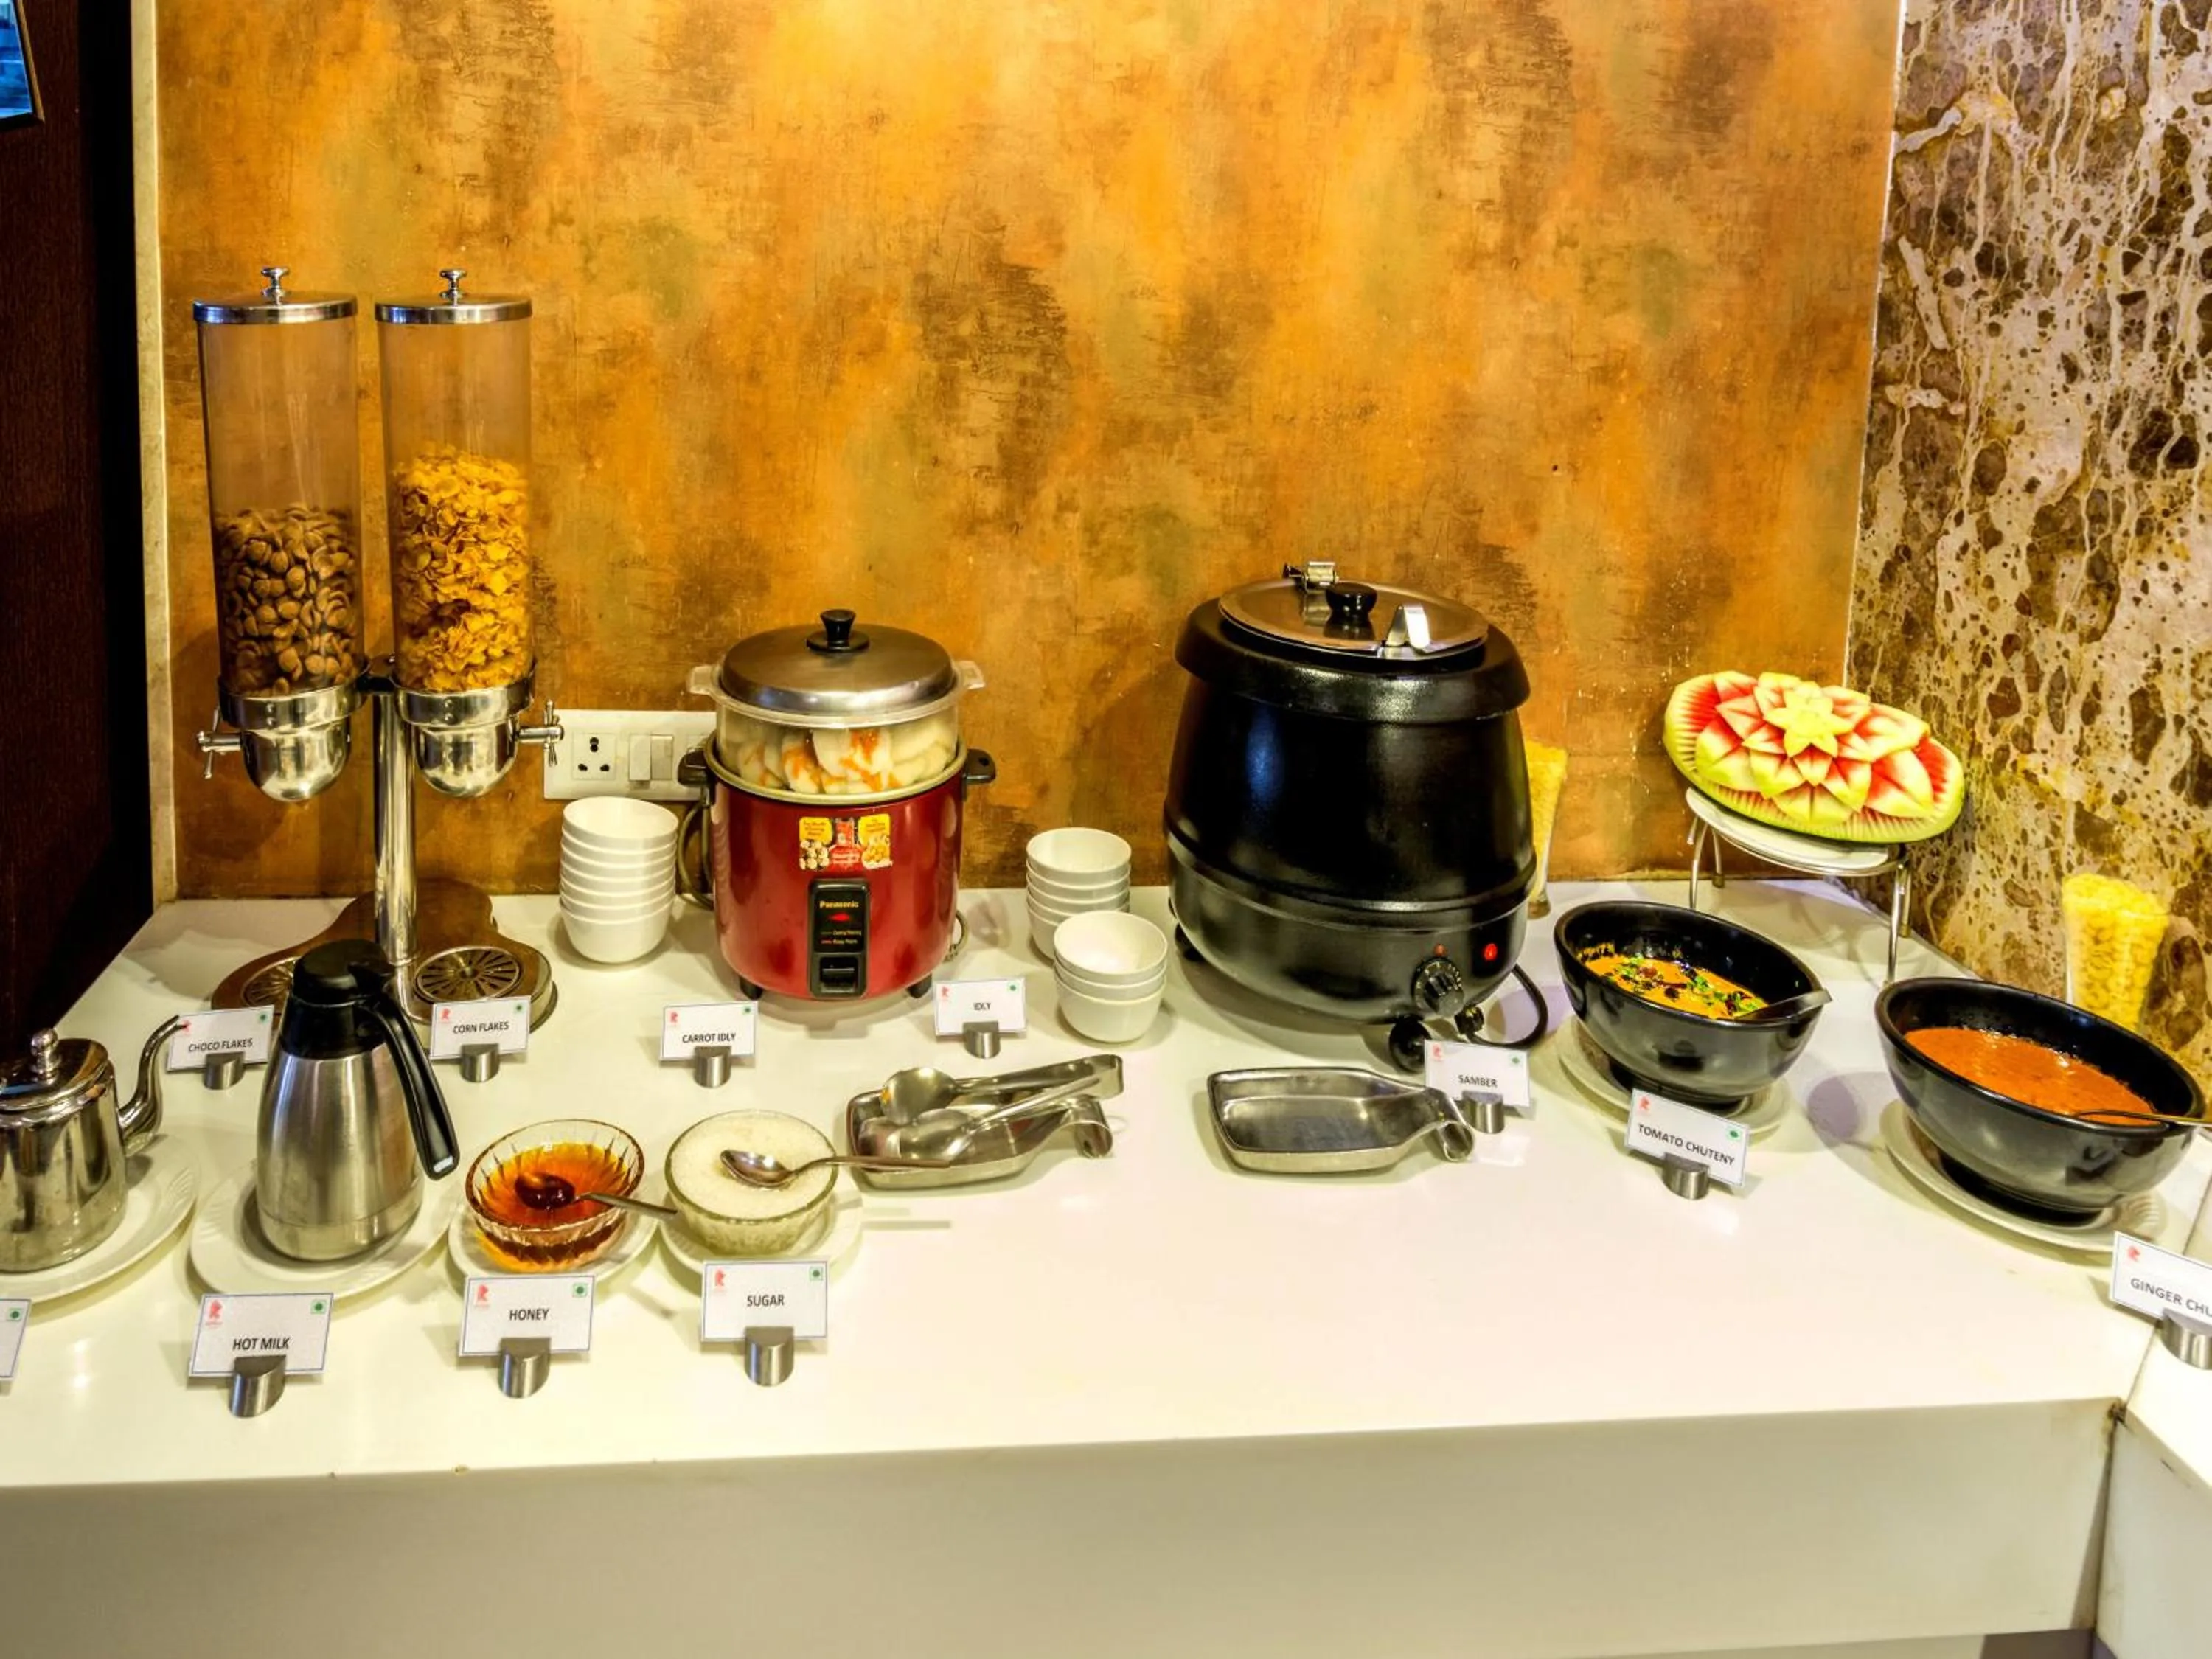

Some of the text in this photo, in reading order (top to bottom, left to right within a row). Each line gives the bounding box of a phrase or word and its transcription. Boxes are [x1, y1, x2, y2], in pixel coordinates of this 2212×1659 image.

[453, 1021, 509, 1034] CORN FLAKES
[682, 1032, 737, 1043] CARROT IDLY
[188, 1037, 253, 1052] CHOCO FLAKES
[1458, 1074, 1498, 1088] SAMBER
[1638, 1124, 1735, 1166] TOMATO CHUTENY
[2130, 1277, 2183, 1306] GINGER
[747, 1295, 785, 1307] SUGAR
[509, 1308, 549, 1321] HONEY
[232, 1338, 290, 1350] HOT MILK
